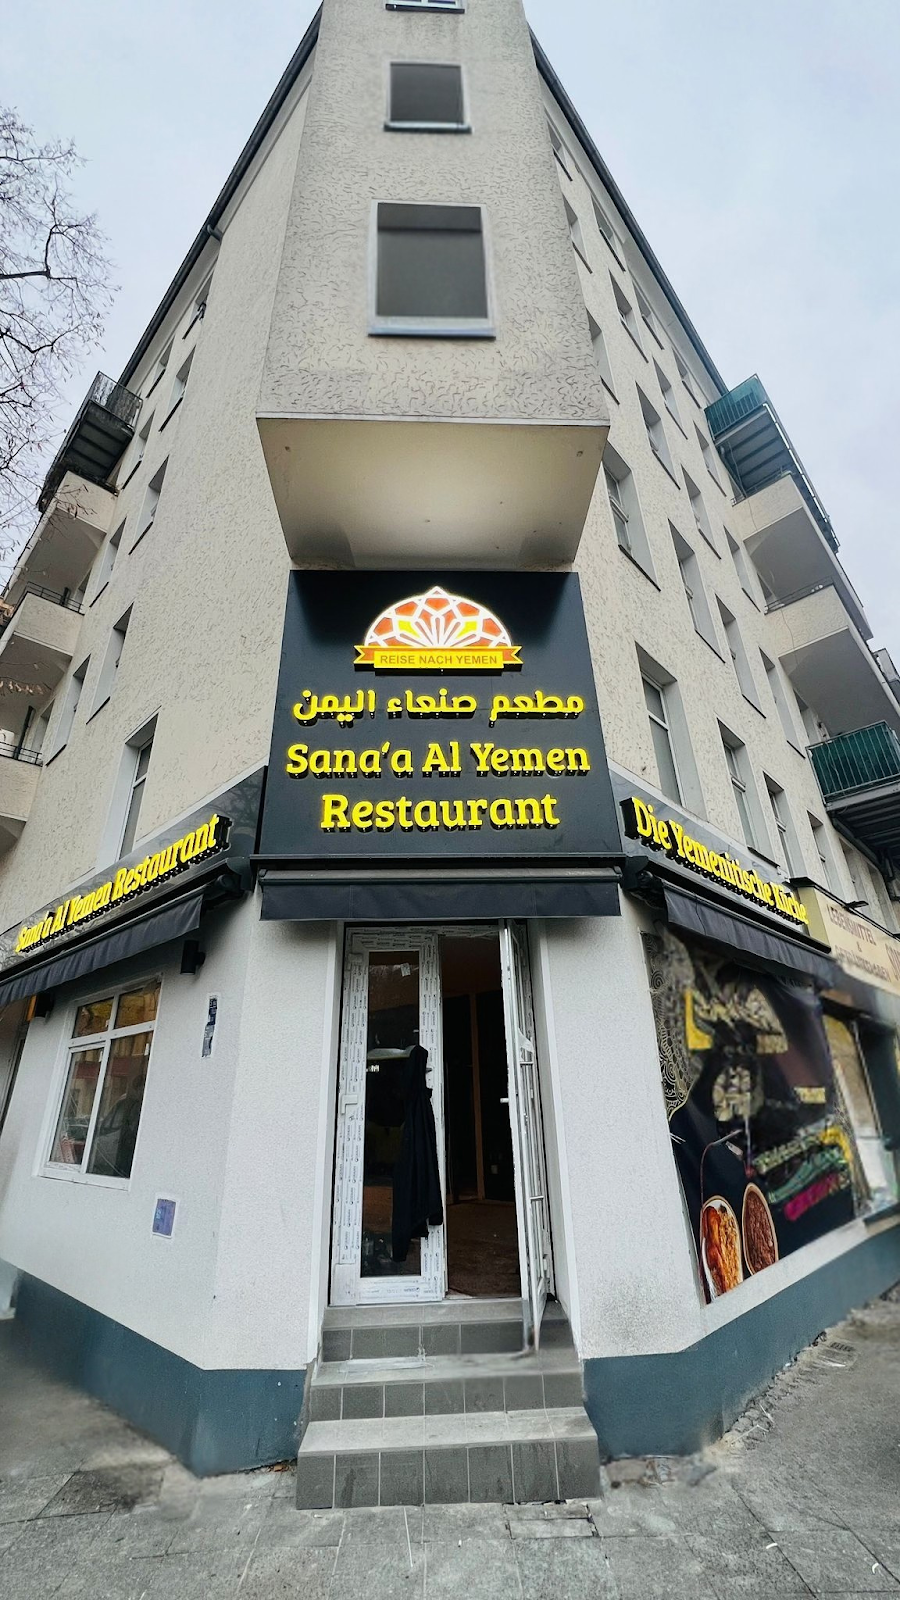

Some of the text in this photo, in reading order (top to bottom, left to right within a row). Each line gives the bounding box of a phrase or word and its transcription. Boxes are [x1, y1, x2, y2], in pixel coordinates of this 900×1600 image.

[380, 655, 497, 665] REISE NACH YEMEN
[293, 688, 585, 723] مطعم صنعاء اليمن
[421, 741, 461, 772] Al
[470, 742, 591, 773] Yemen
[320, 793, 560, 829] Restaurant
[49, 899, 71, 936] Al
[66, 894, 113, 927] Yemen
[111, 813, 220, 902] Restaurant
[631, 796, 809, 925] Die Yemenitische Küche
